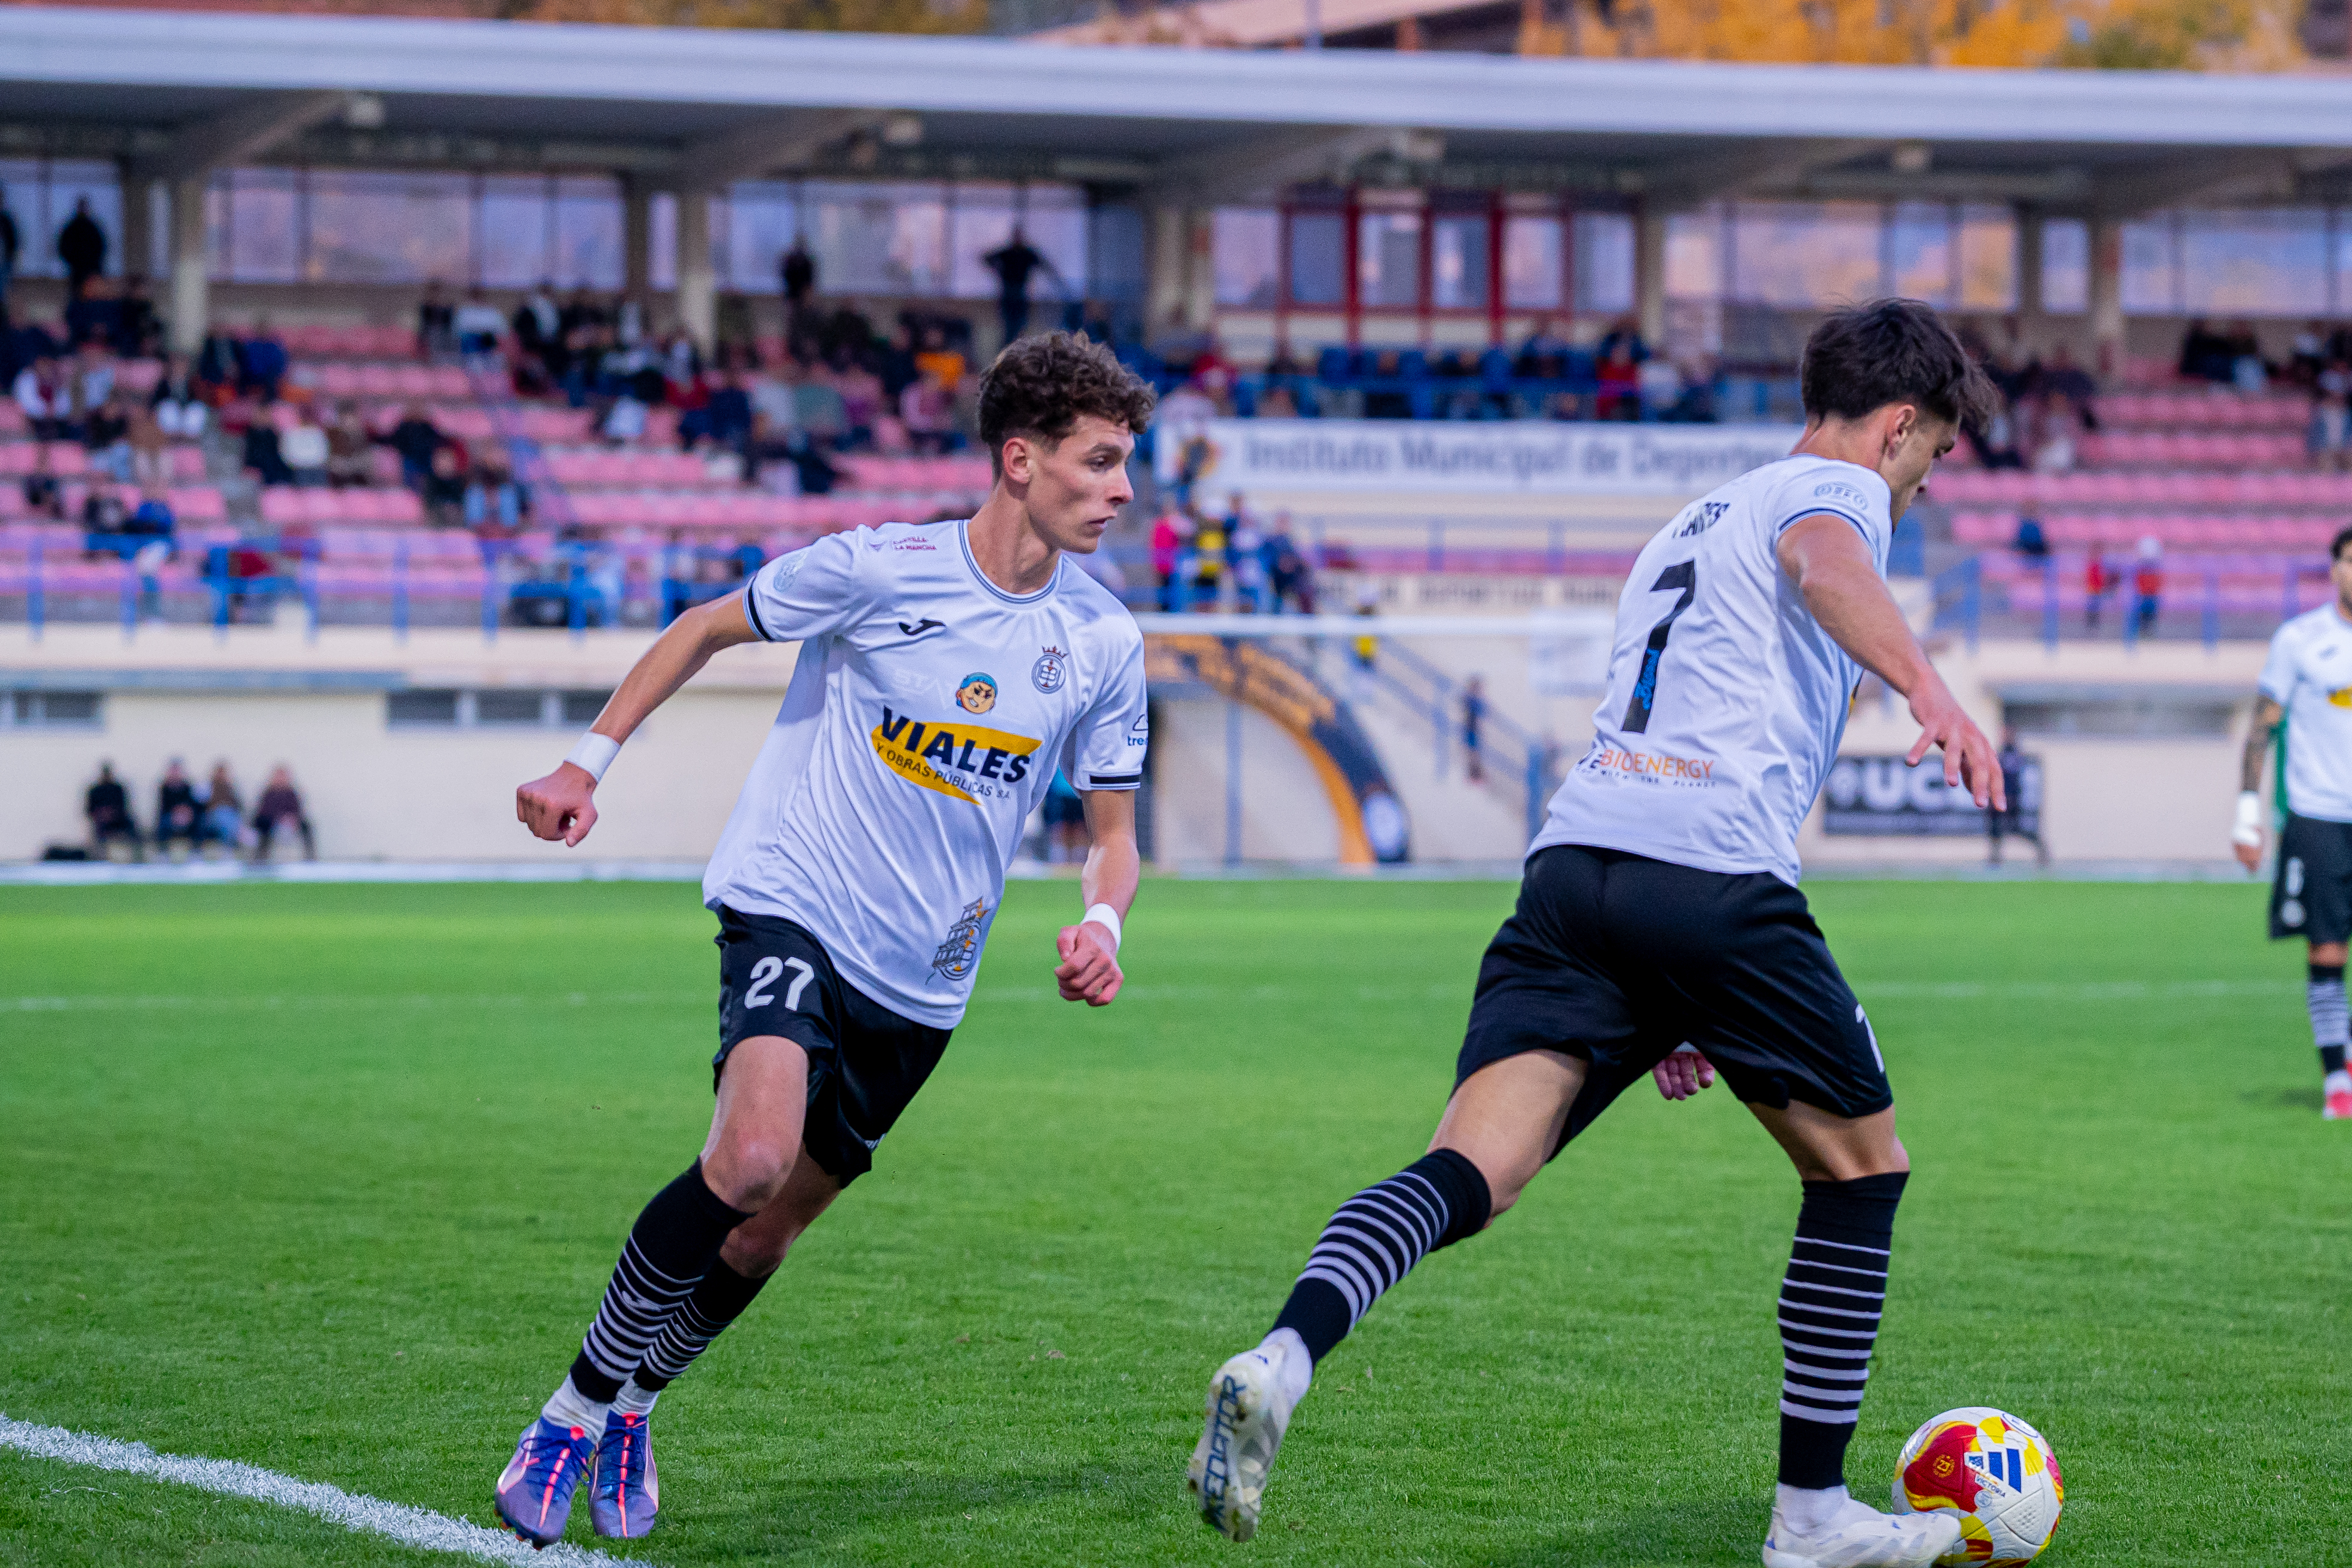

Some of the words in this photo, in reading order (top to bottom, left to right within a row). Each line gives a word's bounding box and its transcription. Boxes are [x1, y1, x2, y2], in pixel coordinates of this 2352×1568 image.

[1248, 439, 1388, 471] Instituto
[1401, 437, 1568, 482] Municipal
[1582, 438, 1619, 472] de
[1620, 557, 1696, 734] 7
[877, 742, 883, 754] Y
[887, 749, 932, 777] OBRAS
[881, 705, 1030, 783] VIALES
[745, 957, 814, 1011] 27
[1977, 1477, 2005, 1497] VICTORIA
